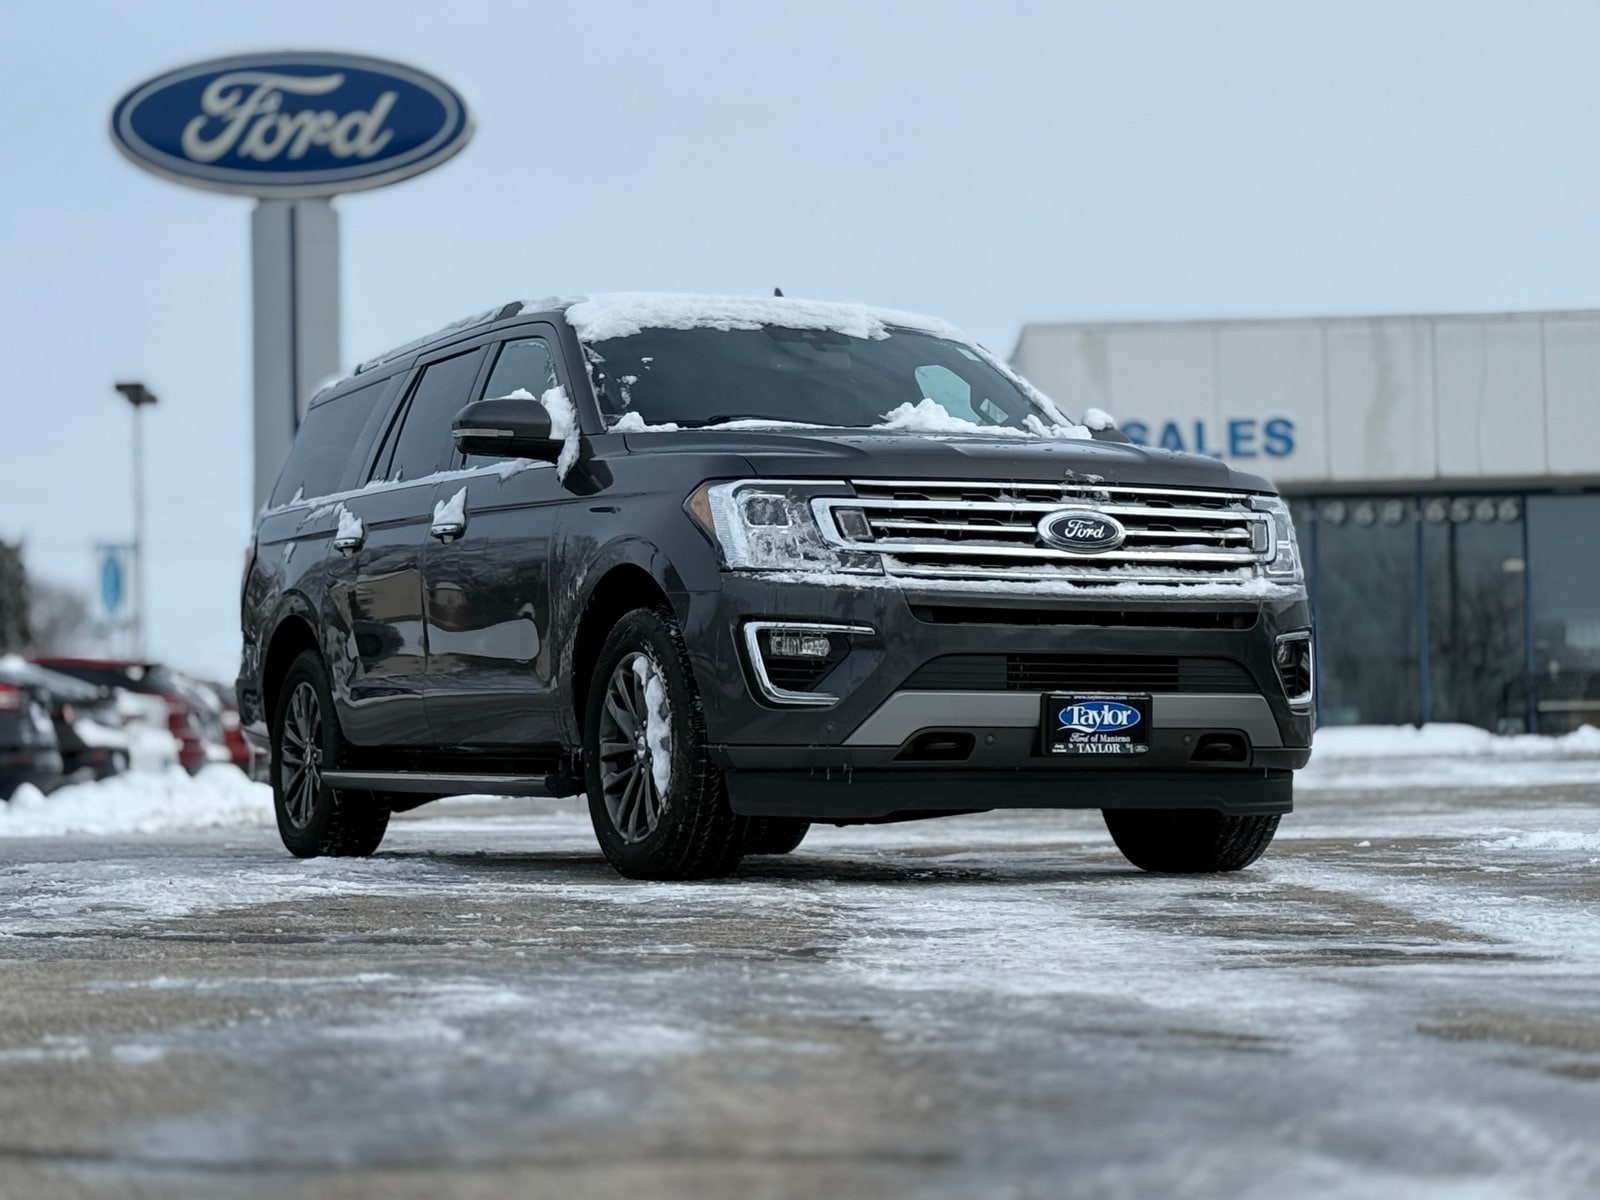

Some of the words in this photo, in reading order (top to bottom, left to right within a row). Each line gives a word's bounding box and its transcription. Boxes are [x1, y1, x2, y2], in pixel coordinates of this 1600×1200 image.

[181, 70, 399, 163] Ford
[1119, 416, 1297, 459] SALES
[1064, 519, 1105, 539] Ford
[1058, 704, 1132, 733] Taylor
[1076, 743, 1121, 754] TAYLOR
[1090, 734, 1099, 743] of
